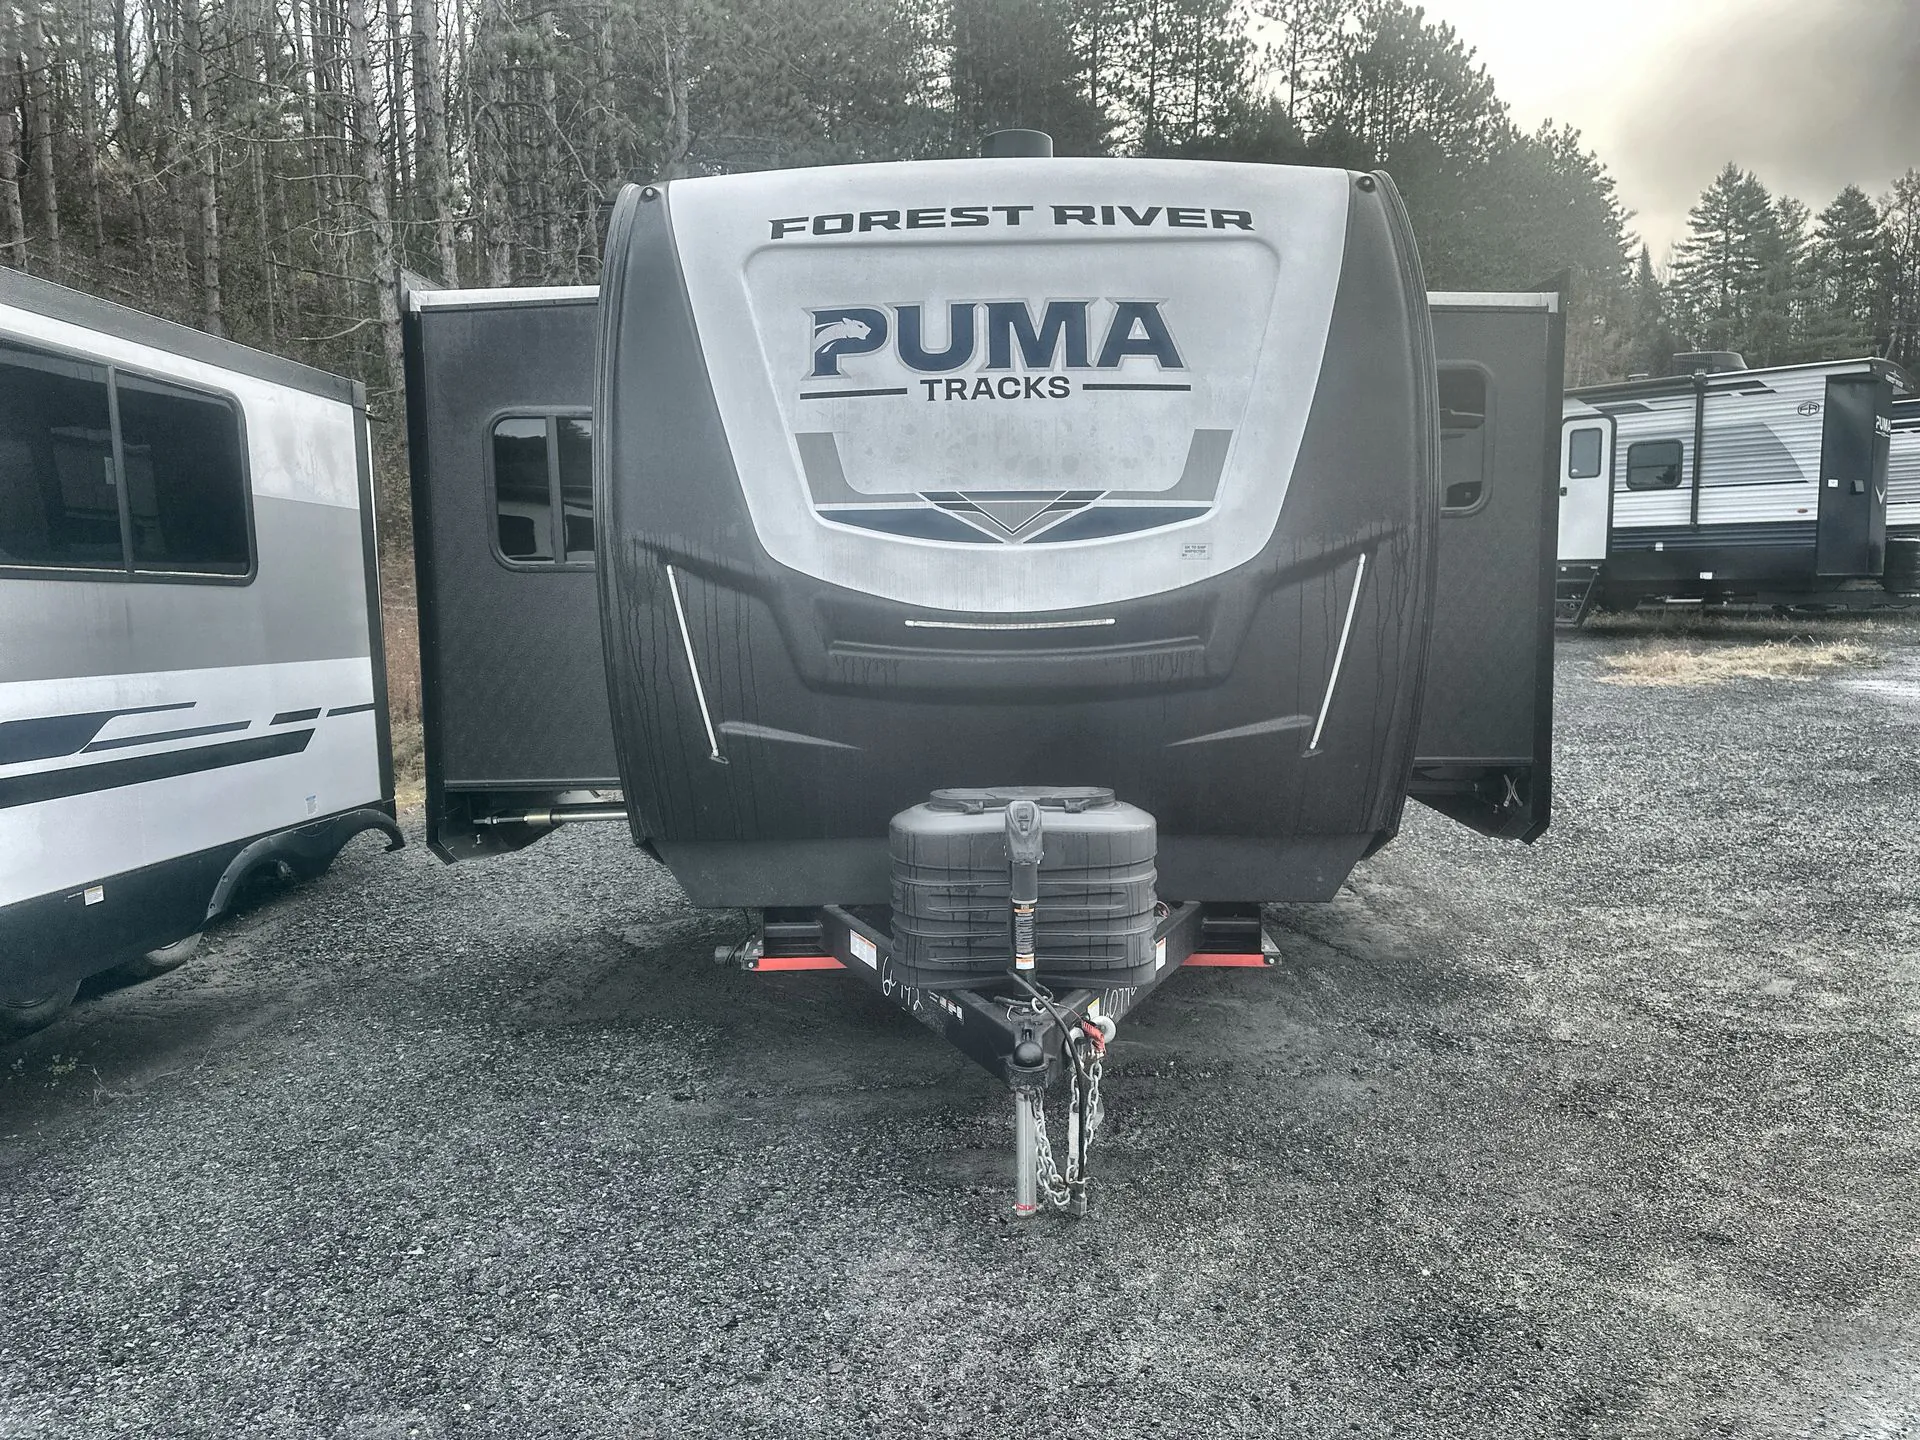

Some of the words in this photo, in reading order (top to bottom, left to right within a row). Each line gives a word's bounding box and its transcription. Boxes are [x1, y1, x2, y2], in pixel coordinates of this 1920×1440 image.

[768, 205, 1033, 240] FOREST
[1049, 205, 1256, 232] RIVER
[804, 299, 1188, 379] PUMA
[919, 375, 1071, 400] TRACKS
